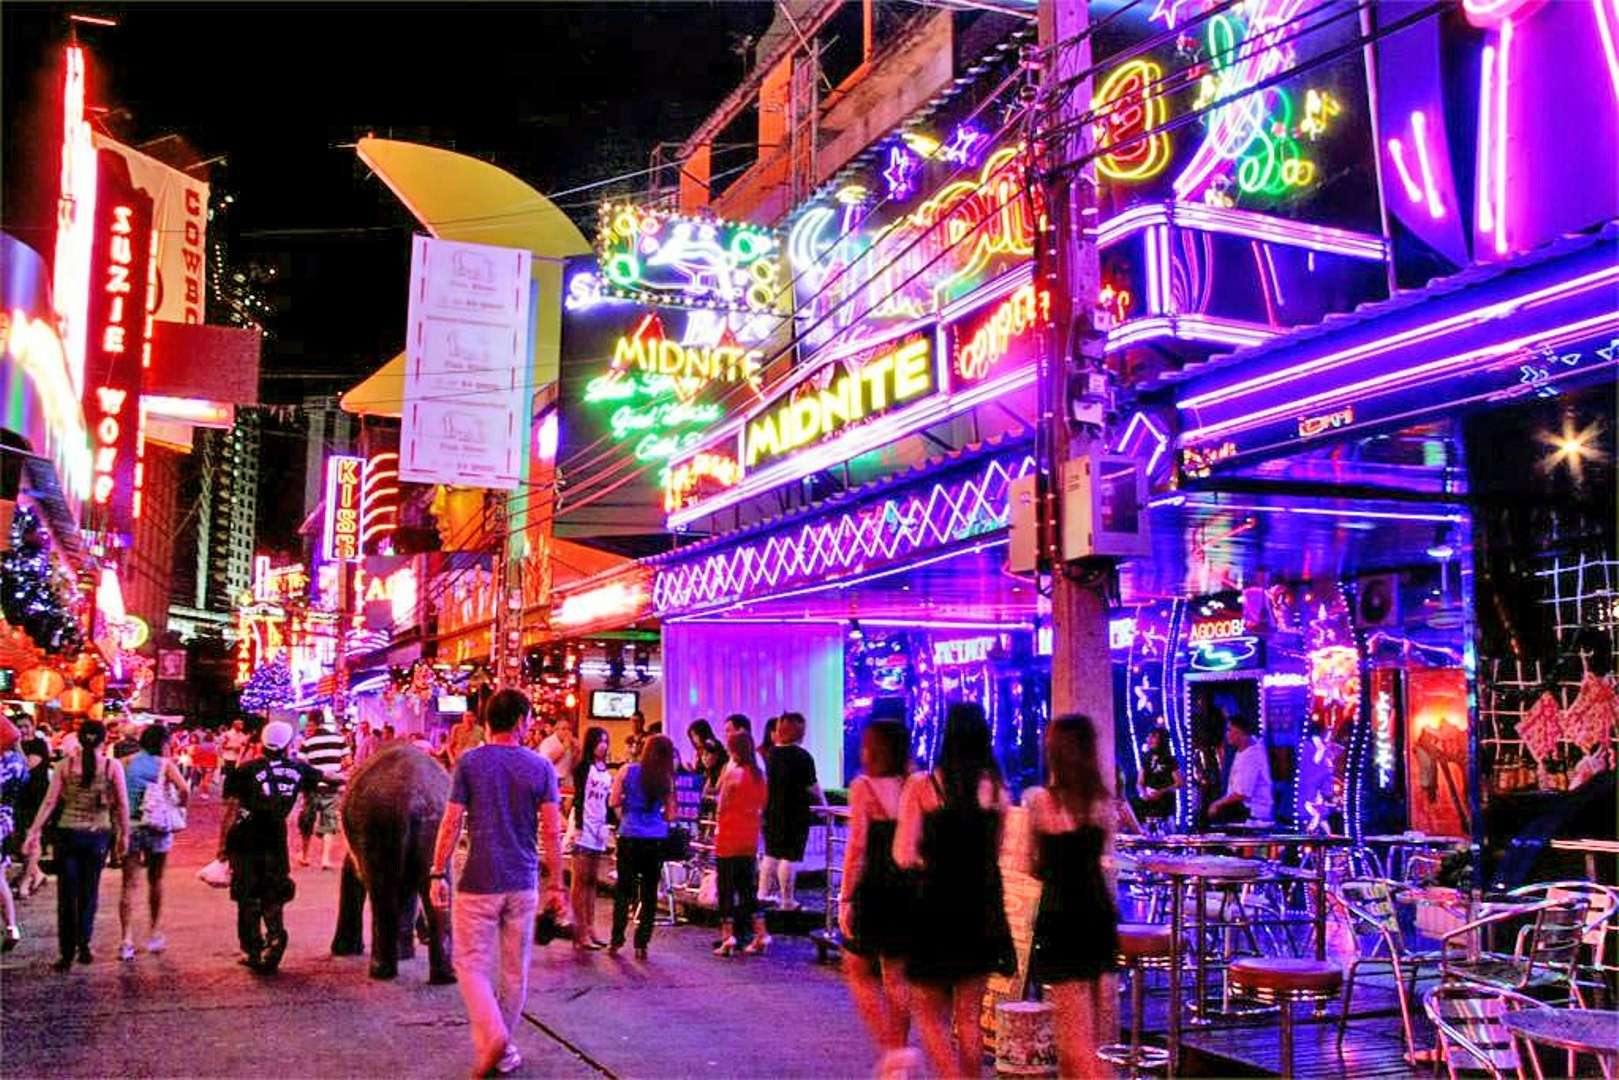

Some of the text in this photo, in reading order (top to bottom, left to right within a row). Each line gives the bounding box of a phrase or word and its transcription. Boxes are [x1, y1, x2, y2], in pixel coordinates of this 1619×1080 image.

[103, 206, 133, 354] SUZIE
[611, 336, 765, 385] MIDNITE
[745, 337, 932, 466] MIDNITE
